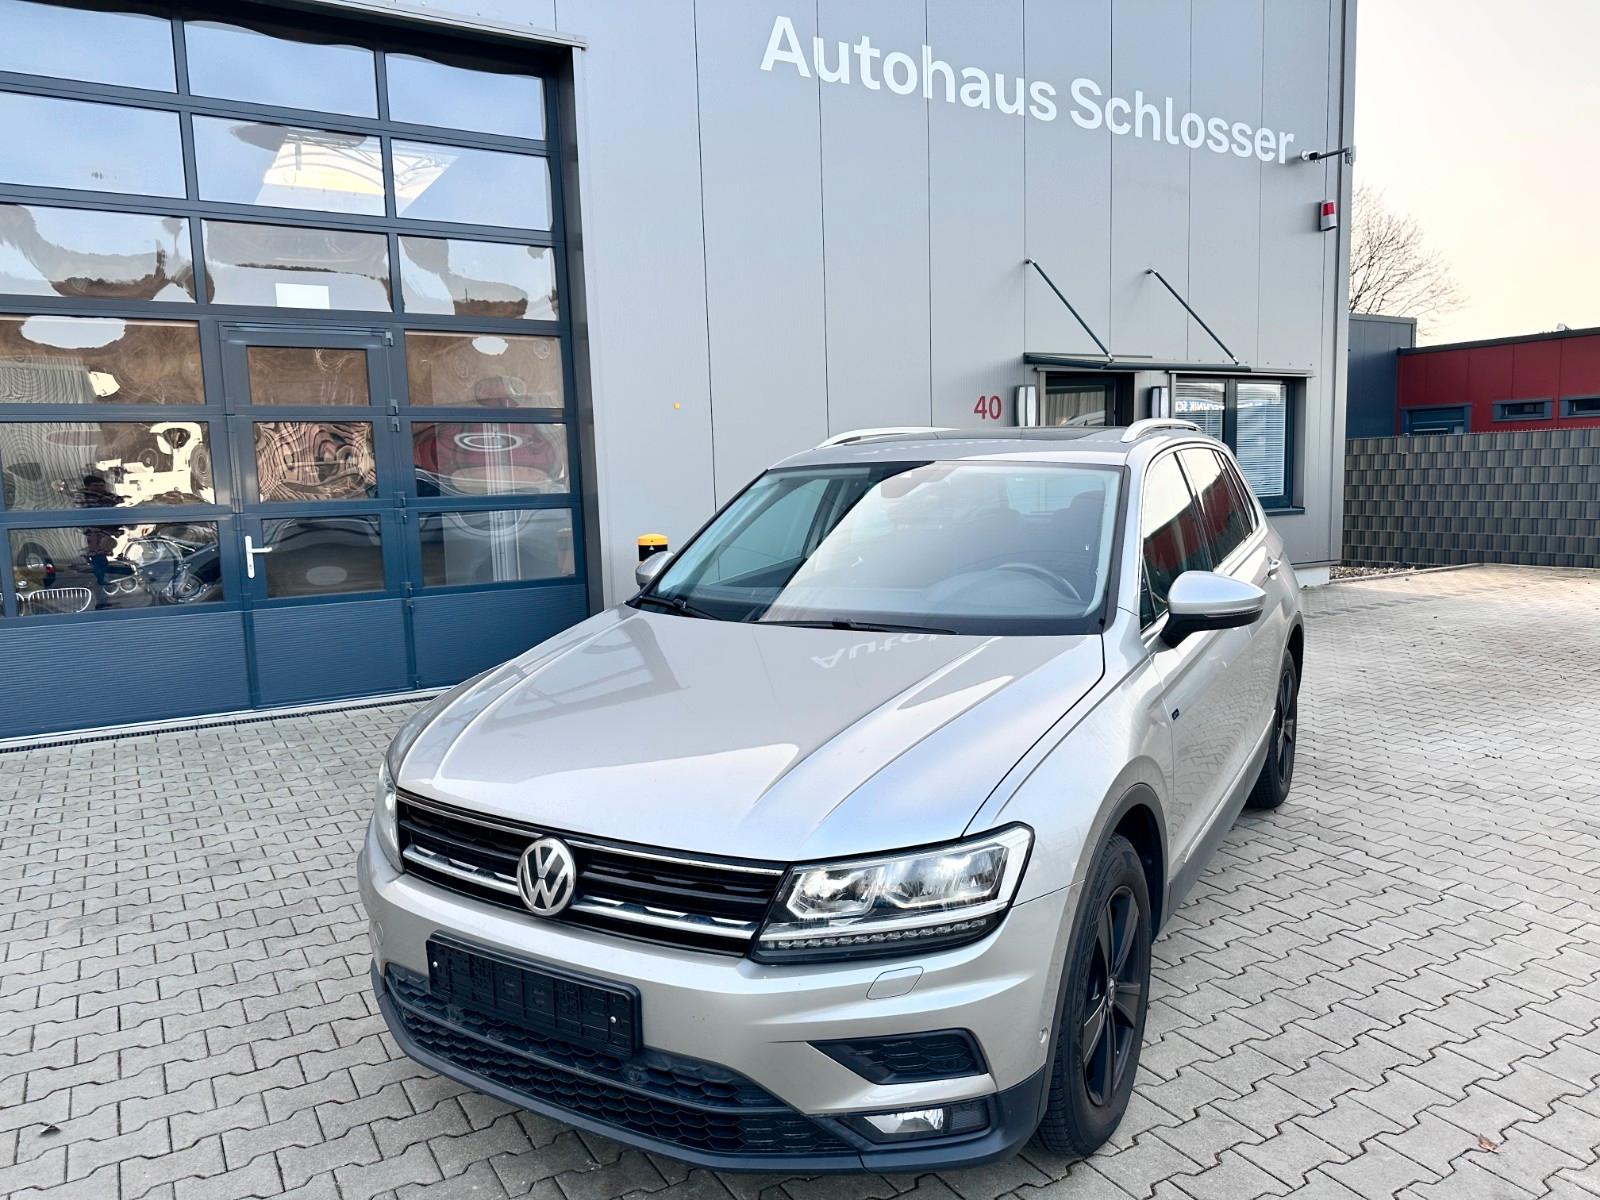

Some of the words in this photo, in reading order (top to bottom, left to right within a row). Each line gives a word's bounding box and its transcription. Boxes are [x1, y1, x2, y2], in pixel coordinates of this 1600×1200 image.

[760, 15, 1057, 122] Autohaus
[1070, 77, 1295, 164] Schlosser
[973, 395, 1002, 420] 40
[519, 839, 574, 913] VW
